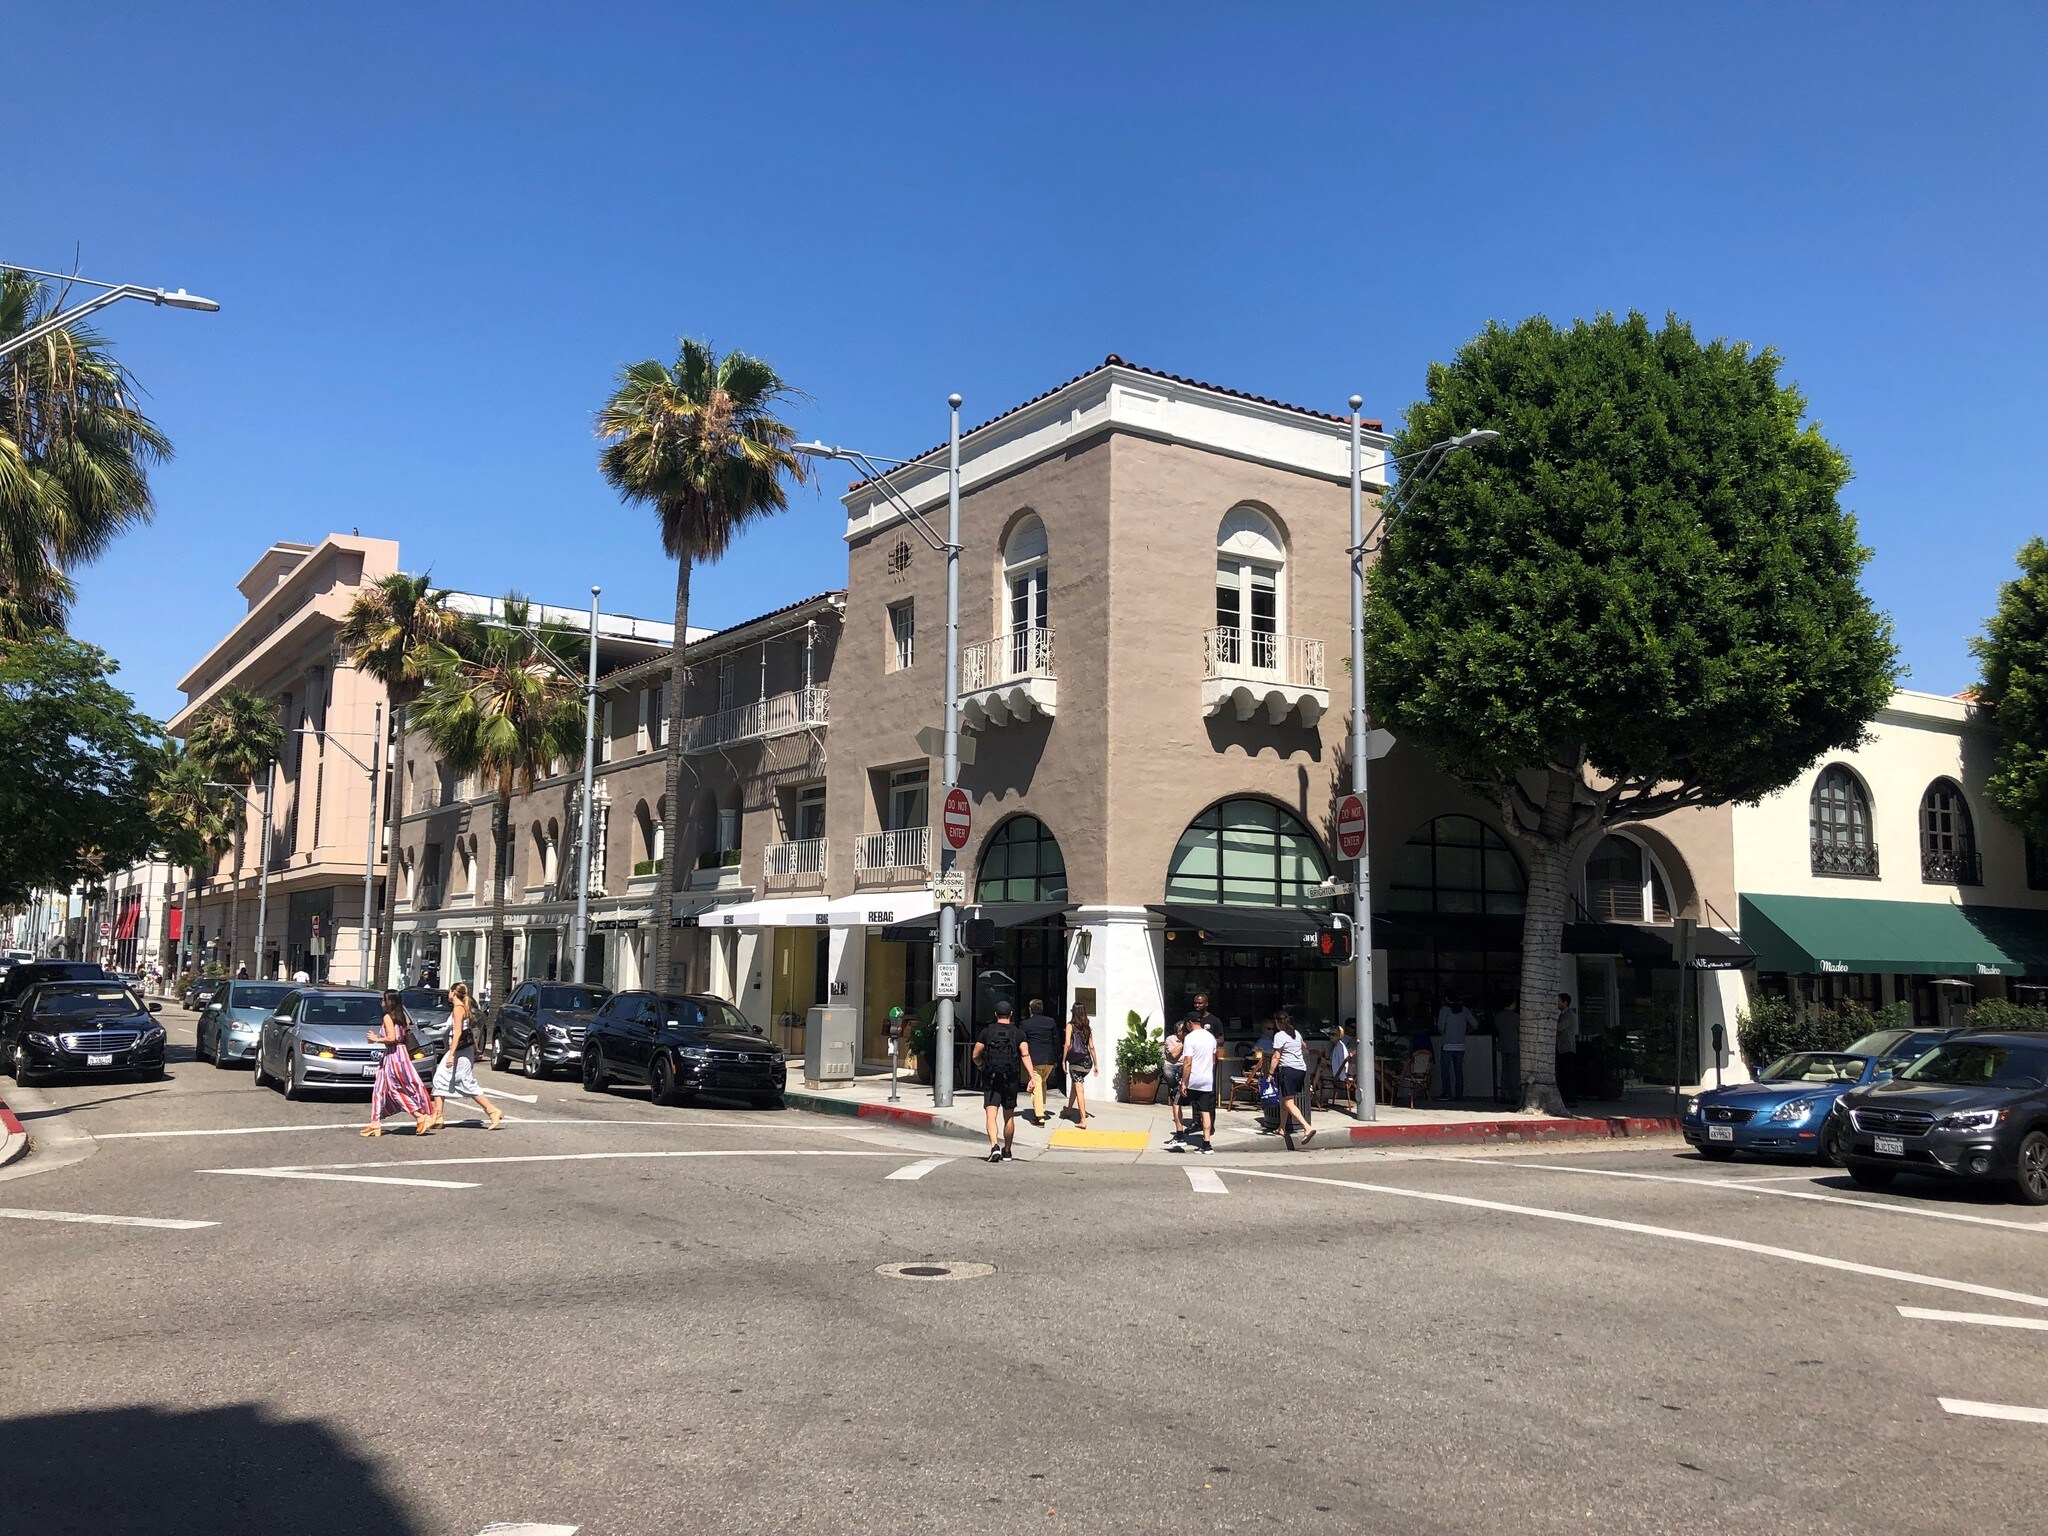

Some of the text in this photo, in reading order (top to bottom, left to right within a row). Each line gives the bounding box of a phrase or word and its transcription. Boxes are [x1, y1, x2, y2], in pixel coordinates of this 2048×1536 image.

[948, 799, 967, 812] DO NOT
[1341, 806, 1361, 820] DO NOT
[949, 827, 966, 839] ENTER
[1344, 836, 1360, 847] ENTER
[934, 889, 946, 899] OK
[1310, 886, 1335, 898] BRIGHTON
[868, 911, 894, 923] REBAG
[1820, 959, 1849, 973] Madeo
[1976, 963, 2001, 975] Madeo
